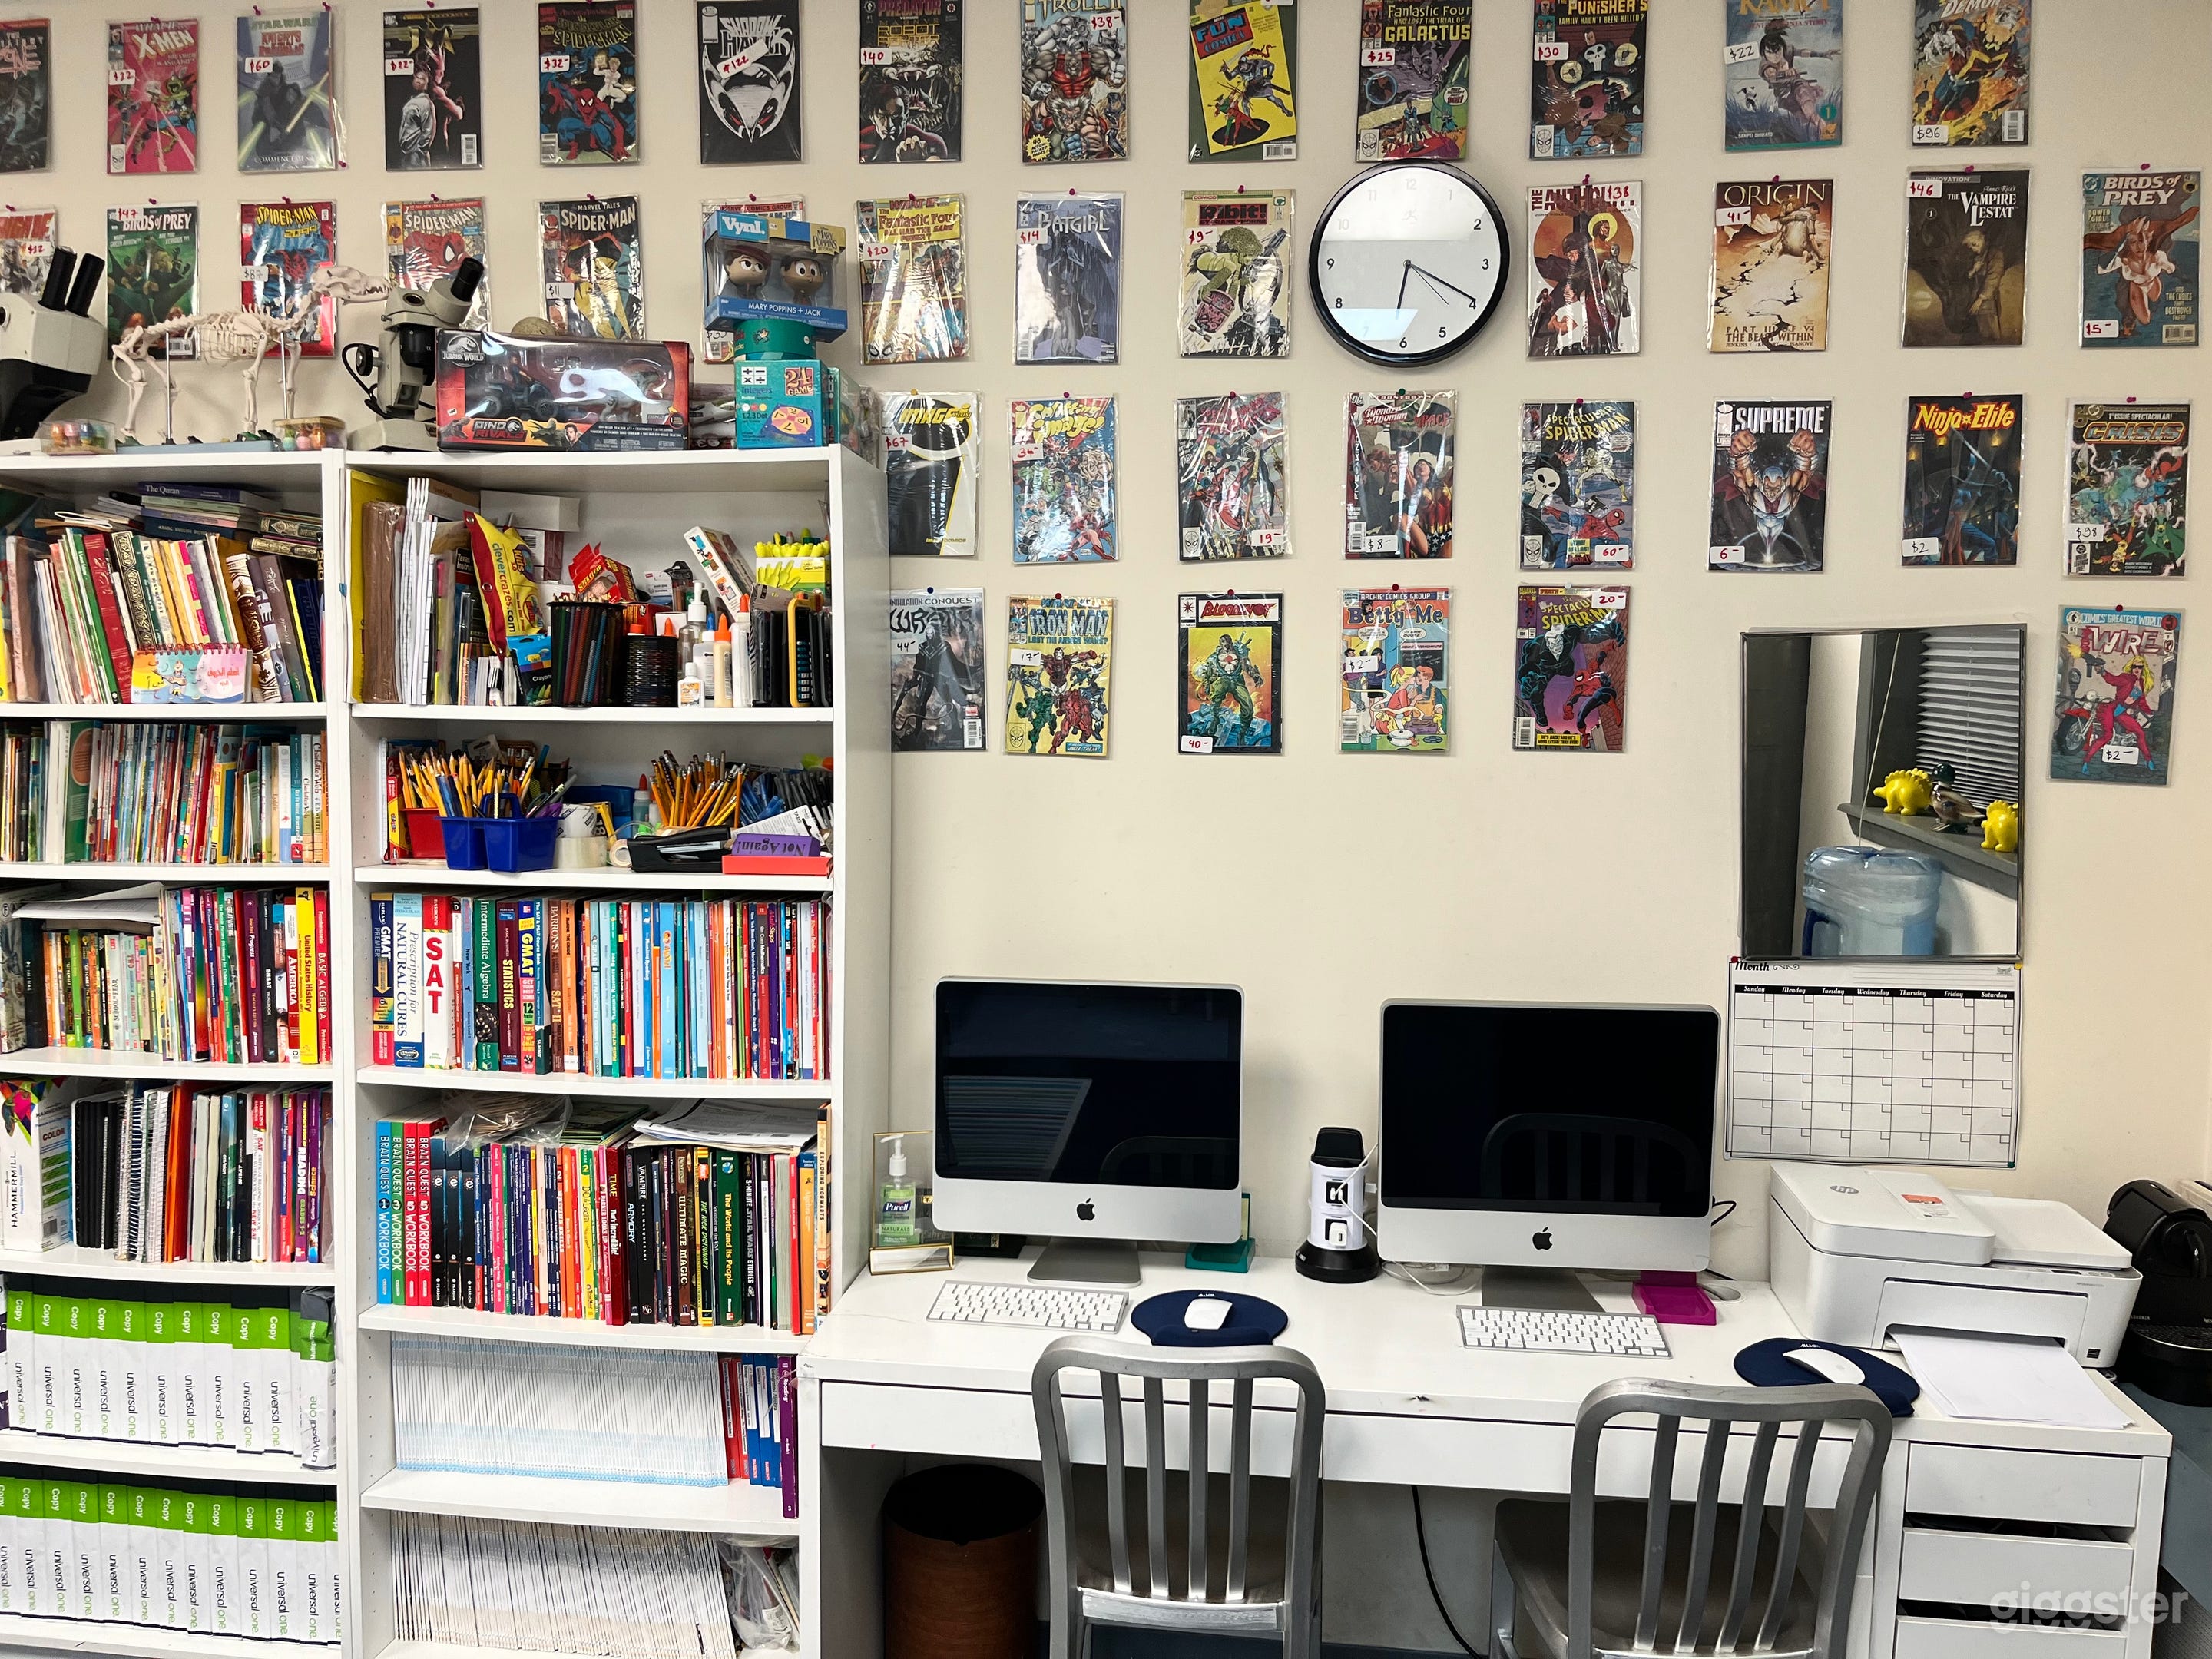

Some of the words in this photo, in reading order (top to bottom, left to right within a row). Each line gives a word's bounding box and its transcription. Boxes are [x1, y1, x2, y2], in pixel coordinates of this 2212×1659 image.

[1388, 5, 1440, 18] Fantastic
[1443, 5, 1472, 16] Four
[877, 24, 939, 35] ROBOT
[1195, 15, 1246, 42] FUN
[1385, 24, 1471, 42] GALACTUS
[1204, 30, 1253, 54] COMICS
[250, 60, 270, 72] $60
[1367, 51, 1392, 62] $25
[2103, 175, 2163, 191] BIRDS
[1724, 184, 1827, 207] ORIGIN
[1961, 191, 2017, 207] VAMPIRE
[2101, 189, 2175, 206] PREY
[123, 215, 154, 232] BIRDS
[162, 213, 192, 232] PREY
[878, 214, 930, 232] Fantastic
[931, 212, 959, 226] Four
[1038, 210, 1110, 233] BATGIRL
[1474, 219, 1481, 230] 2
[1970, 205, 2015, 227] LESTAT
[813, 237, 837, 250] POPPINS
[816, 230, 833, 240] MARY
[1327, 259, 1334, 270] 9
[1482, 258, 1489, 270] 3
[748, 302, 768, 311] MARY
[769, 303, 796, 314] POPPINS
[804, 307, 821, 316] JACK
[1336, 297, 1343, 309] 8
[1469, 299, 1476, 310] 4
[1399, 337, 1407, 349] 6
[1439, 326, 1446, 338] 5
[785, 367, 813, 388] 24
[787, 385, 813, 396] GAME
[474, 420, 506, 431] DINO
[1373, 412, 1407, 424] Woman
[1735, 406, 1824, 433] SUPREME
[1915, 404, 1962, 435] Ninja
[1973, 403, 2015, 429] Elite
[886, 436, 909, 449] $67
[146, 485, 157, 493] The
[159, 486, 180, 495] Quran
[1912, 541, 1929, 554] $2
[924, 597, 979, 605] CONQUEST
[1029, 608, 1068, 635] IRON
[1071, 610, 1108, 637] MAN
[1347, 606, 1405, 627] Betty
[1414, 605, 1443, 624] Me
[2108, 614, 2137, 625] GREATEST
[2139, 616, 2162, 626] WORLD
[2086, 626, 2163, 654] WIRE
[737, 838, 780, 855] Again!
[783, 843, 806, 856] Not
[481, 901, 490, 959] Intermediate
[381, 926, 391, 961] GMAT
[397, 922, 407, 988] NATURAL
[521, 933, 533, 975] GMAT
[408, 932, 419, 996] Prescription
[426, 937, 444, 1014] SAT
[1735, 962, 1770, 971] Month
[288, 956, 297, 1005] AMERICA
[480, 961, 489, 999] Algebra
[502, 959, 514, 1009] STATISTICS
[1743, 985, 1765, 994] Sunday
[1782, 986, 1806, 995] Monday
[1899, 989, 1926, 998] Thursday
[1944, 990, 1964, 998] Friday
[396, 991, 407, 1037] CURES
[523, 1002, 533, 1014] 12
[41, 1128, 65, 1141] COLOR
[380, 1137, 389, 1162] BRAIN
[406, 1137, 415, 1165] BRAIN
[297, 1147, 306, 1195] READING
[379, 1164, 389, 1195] QUEST
[392, 1164, 402, 1197] QUEST
[406, 1167, 416, 1198] QUEST
[637, 1165, 646, 1200] VAMPIRE
[10, 1154, 18, 1227] HAMMERMILL
[886, 1202, 909, 1211] Purell
[627, 1203, 635, 1243] ARMORY
[678, 1195, 687, 1246] ULTIMATE
[379, 1212, 389, 1270] WORKBOOK
[392, 1212, 402, 1271] WORKBOOK
[406, 1214, 416, 1272] WORKBOOK
[42, 1304, 51, 1327] Copy
[124, 1310, 132, 1333] Copy
[240, 1317, 249, 1341] Copy
[44, 1366, 55, 1408] universal
[127, 1373, 137, 1415] universal
[243, 1382, 253, 1425] universal
[51, 1488, 60, 1512] Copy
[55, 1551, 65, 1591] universal
